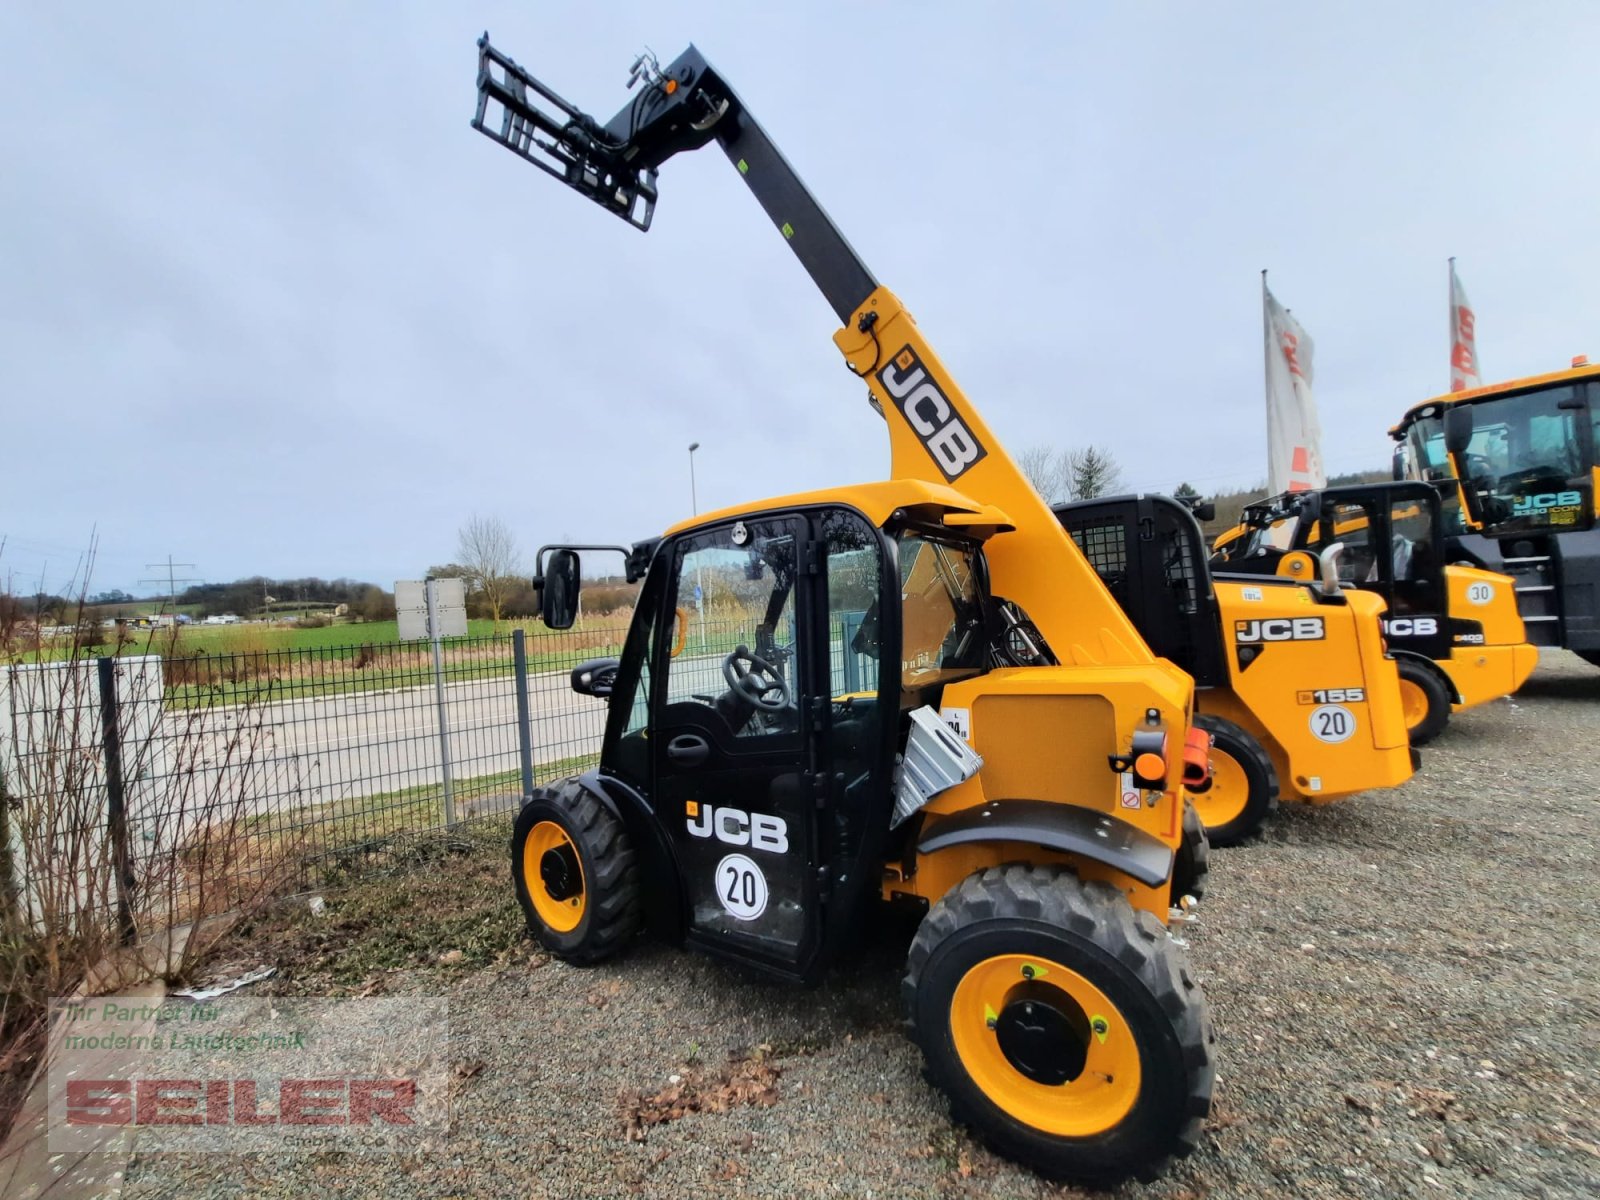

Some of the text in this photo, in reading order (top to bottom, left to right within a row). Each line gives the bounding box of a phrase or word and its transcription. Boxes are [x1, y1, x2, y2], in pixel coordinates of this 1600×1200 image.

[882, 360, 978, 476] JCB
[1513, 491, 1581, 510] JCB
[1471, 586, 1489, 600] 30
[1236, 617, 1324, 642] JCB
[1314, 688, 1364, 704] 155
[1319, 712, 1346, 736] 20
[686, 801, 789, 854] JCB
[727, 866, 756, 907] 20
